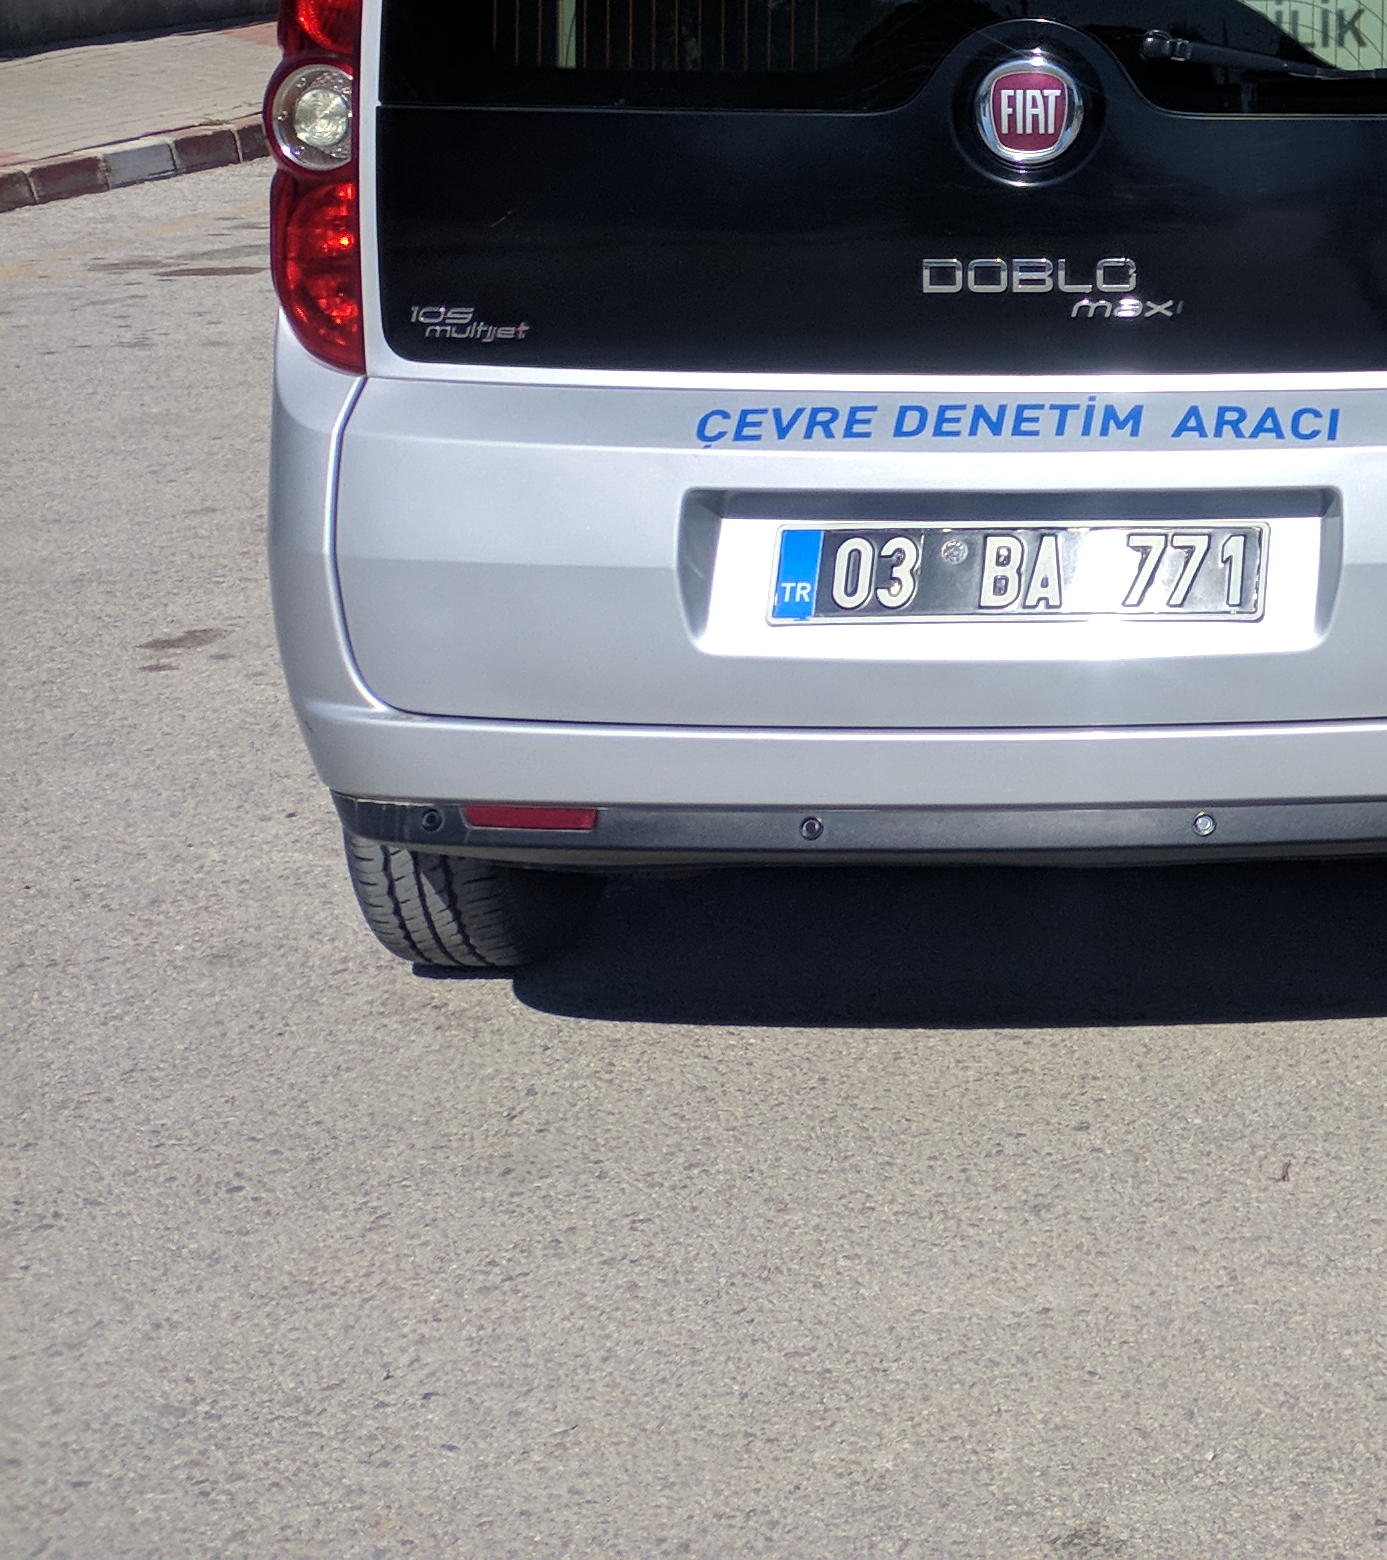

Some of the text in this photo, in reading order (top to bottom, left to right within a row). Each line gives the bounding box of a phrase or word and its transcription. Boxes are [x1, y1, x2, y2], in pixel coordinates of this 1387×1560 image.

[1000, 89, 1062, 135] FIAT
[922, 257, 1138, 294] DOBLO
[1070, 297, 1184, 318] maxi
[425, 321, 530, 343] multijet
[696, 396, 1341, 449] ÇEVRE DENETİM ARACI
[781, 535, 1246, 609] TR 03 BA 771
